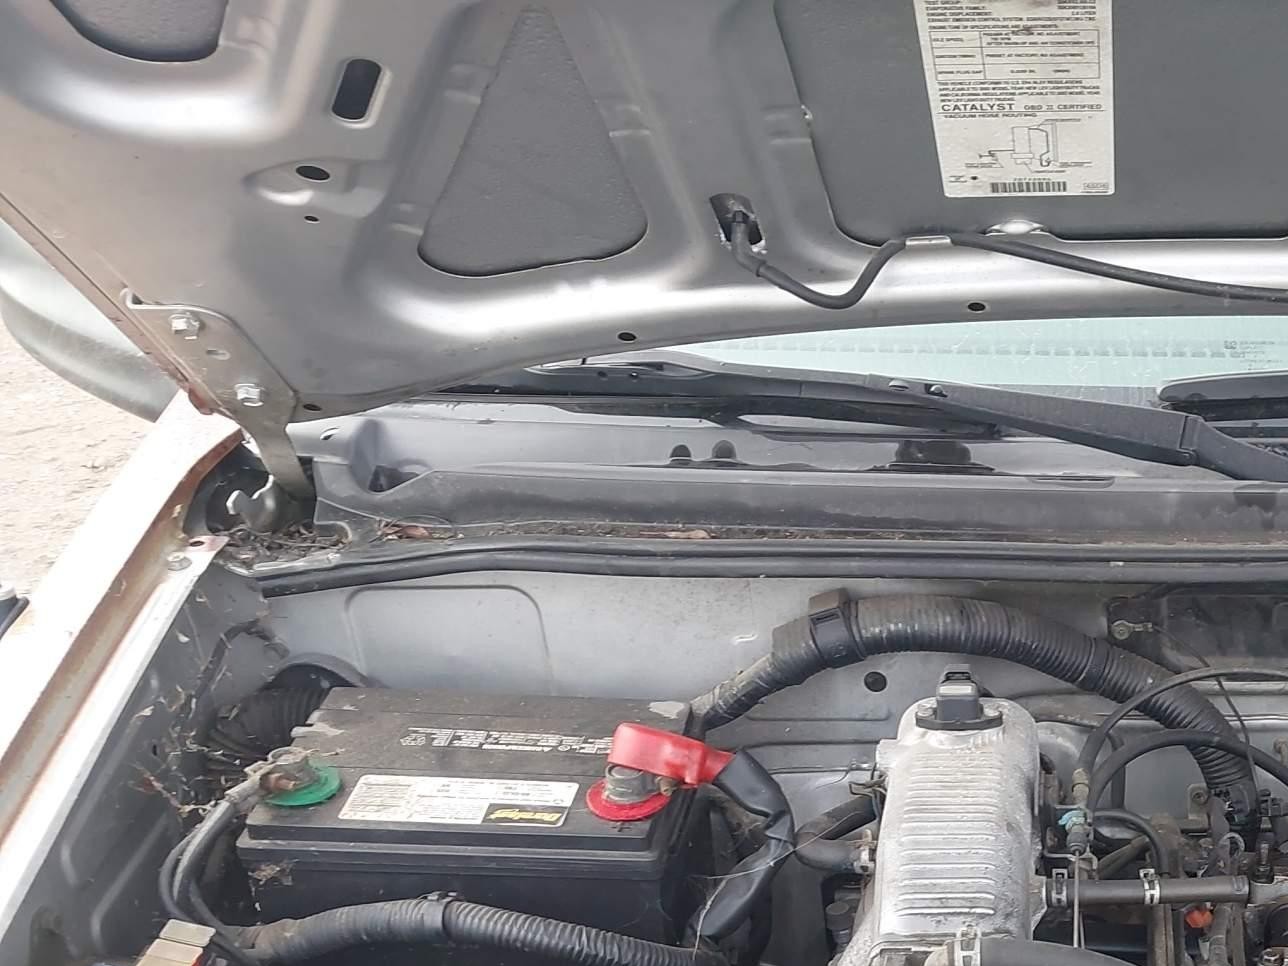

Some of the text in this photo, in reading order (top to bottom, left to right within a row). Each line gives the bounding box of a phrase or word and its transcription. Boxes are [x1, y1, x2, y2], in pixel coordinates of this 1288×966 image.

[941, 103, 1015, 111] CATALYST
[1024, 103, 1043, 111] OBD
[1057, 103, 1102, 111] CERTIFIED
